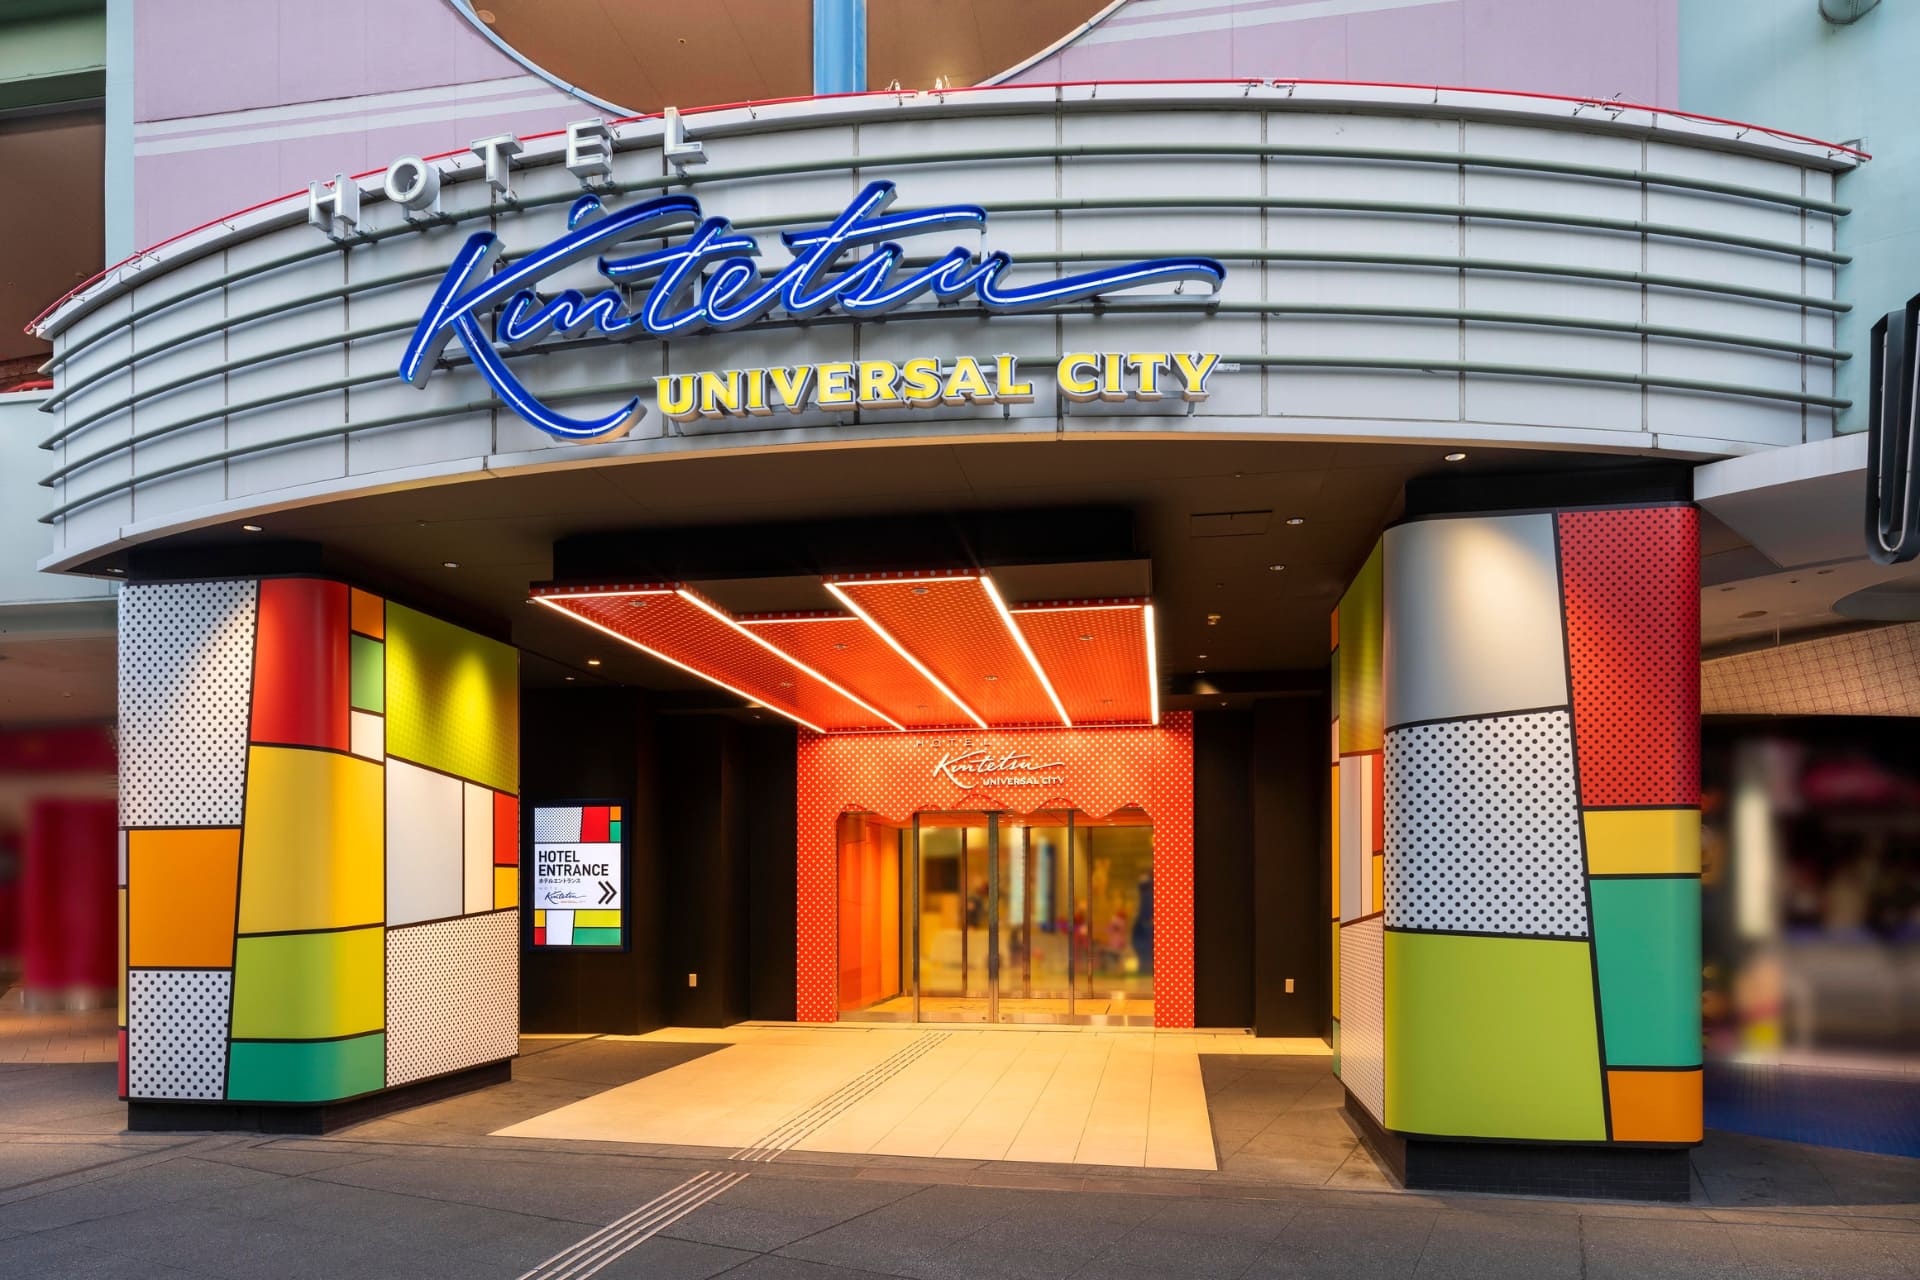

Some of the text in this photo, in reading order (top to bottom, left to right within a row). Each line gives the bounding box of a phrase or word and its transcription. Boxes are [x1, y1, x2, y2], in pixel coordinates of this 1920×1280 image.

[308, 107, 709, 233] HOTEL
[400, 180, 1227, 443] Kintetsu
[654, 351, 1222, 421] UNIVERSAL CITY
[915, 738, 991, 749] HOTEL
[932, 750, 1065, 789] Kintetsu
[983, 775, 1065, 786] UNIVERSAL CITY
[538, 850, 580, 863] HOTEL
[538, 864, 609, 876] ENTRANCE
